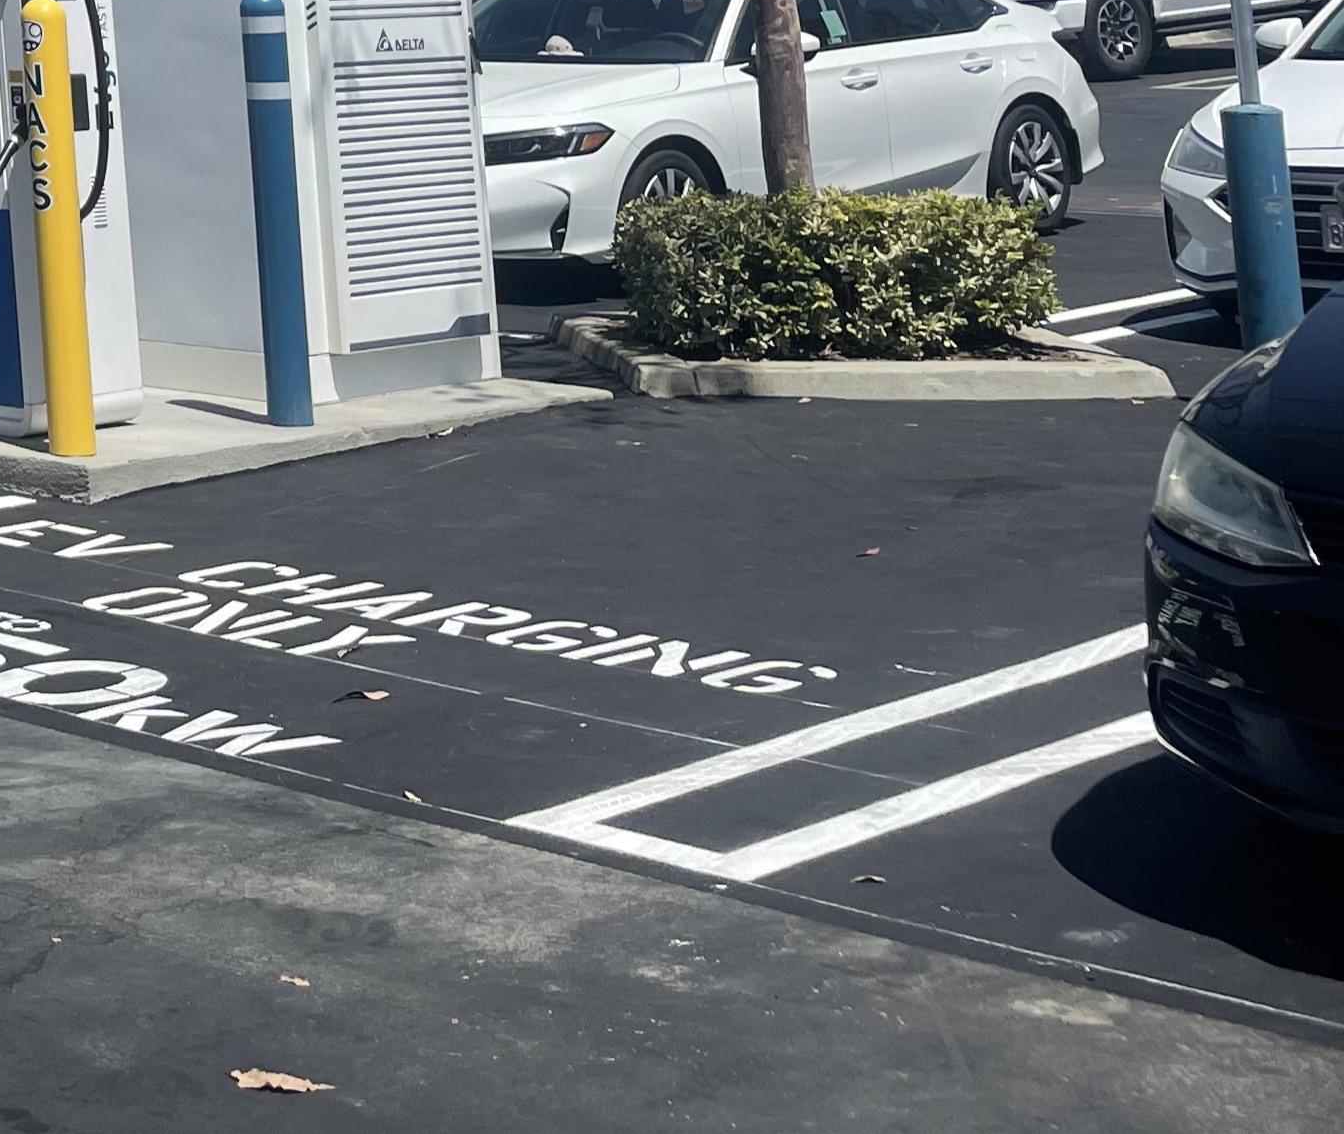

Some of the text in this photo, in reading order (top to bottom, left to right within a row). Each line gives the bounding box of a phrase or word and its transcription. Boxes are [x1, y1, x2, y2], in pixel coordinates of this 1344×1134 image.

[98, 5, 109, 40] FAST
[395, 38, 425, 51] DELTA
[24, 64, 51, 211] NACS
[82, 586, 416, 657] ONLY
[178, 560, 837, 695] CHARGING
